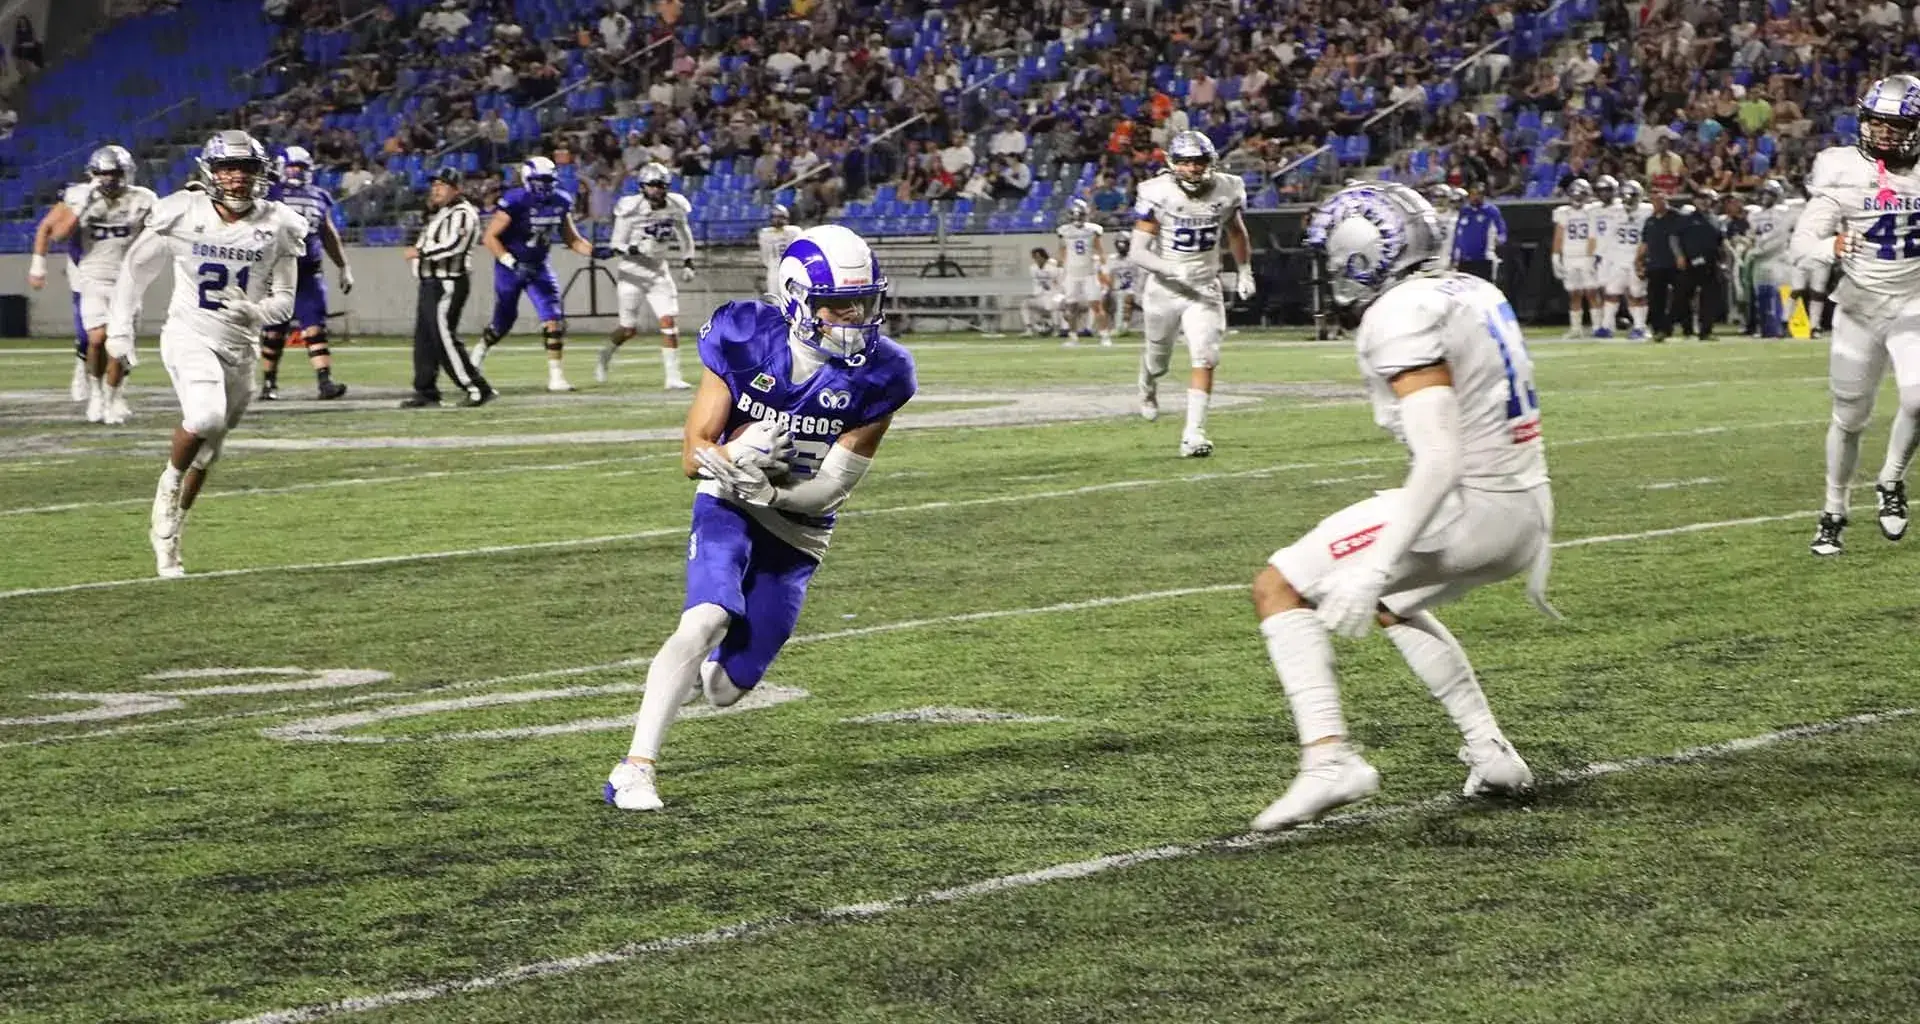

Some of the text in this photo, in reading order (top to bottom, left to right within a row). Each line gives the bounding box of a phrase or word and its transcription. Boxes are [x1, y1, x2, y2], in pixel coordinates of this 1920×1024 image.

[192, 243, 264, 262] BORREGOS
[198, 262, 250, 311] 21
[737, 391, 844, 435] BORREGOS
